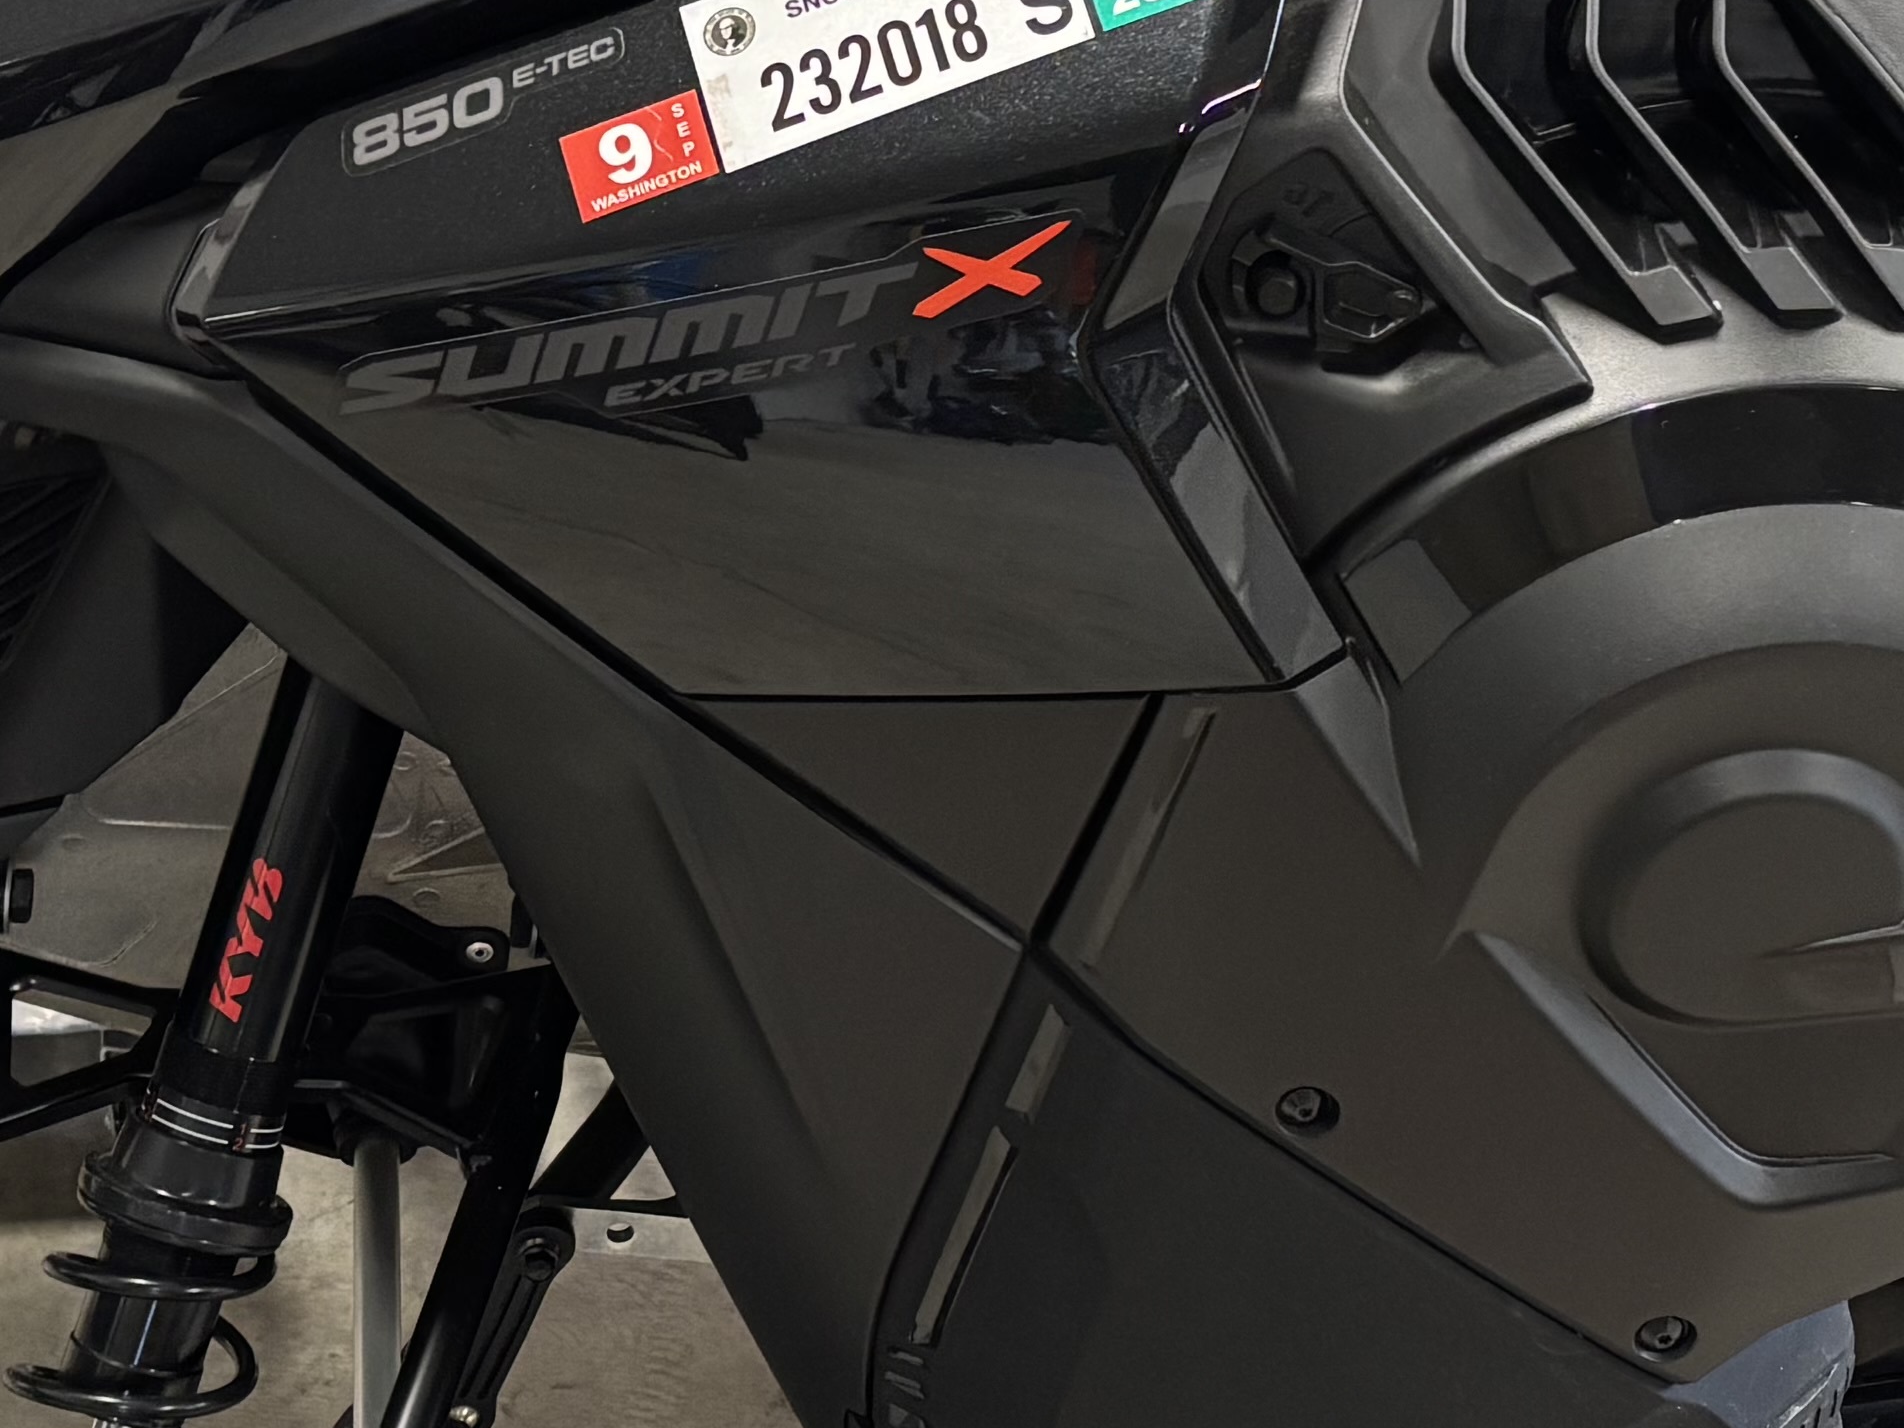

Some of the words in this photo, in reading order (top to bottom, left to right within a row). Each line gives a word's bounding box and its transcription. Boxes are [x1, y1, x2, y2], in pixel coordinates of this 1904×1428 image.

[352, 76, 504, 166] 850
[512, 36, 616, 89] E-TEC
[670, 103, 696, 158] SEP
[591, 160, 703, 213] WASHINGTON
[598, 123, 653, 185] 9
[339, 262, 919, 416] SUMMIT
[912, 219, 1073, 319] X
[602, 342, 858, 409] EXPERT
[209, 857, 283, 1023] KYB
